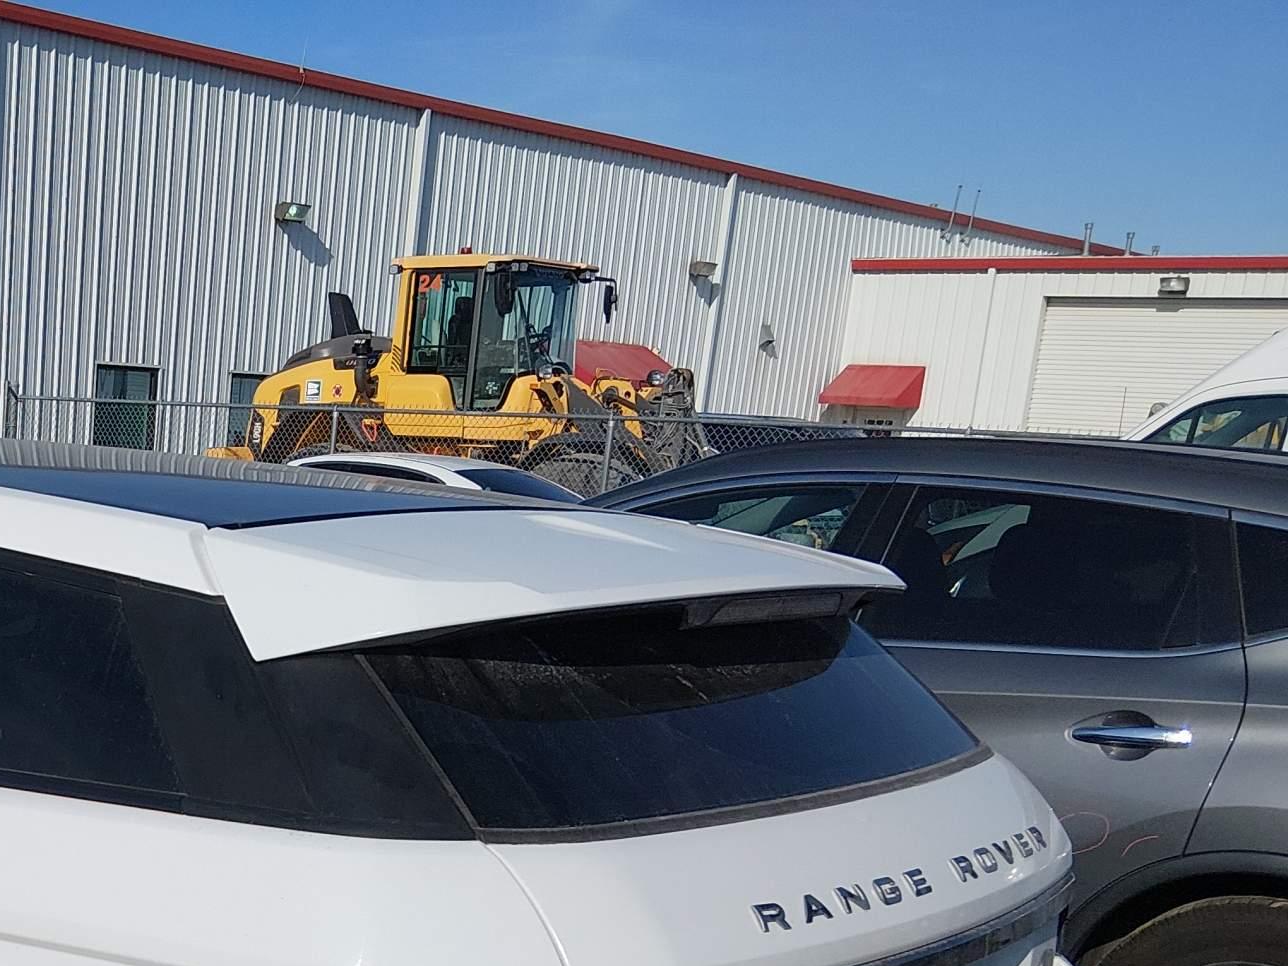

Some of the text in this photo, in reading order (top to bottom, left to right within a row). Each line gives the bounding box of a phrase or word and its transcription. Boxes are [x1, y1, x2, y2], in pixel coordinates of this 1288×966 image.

[419, 273, 442, 293] 24
[751, 825, 1047, 932] RANGE ROVER
